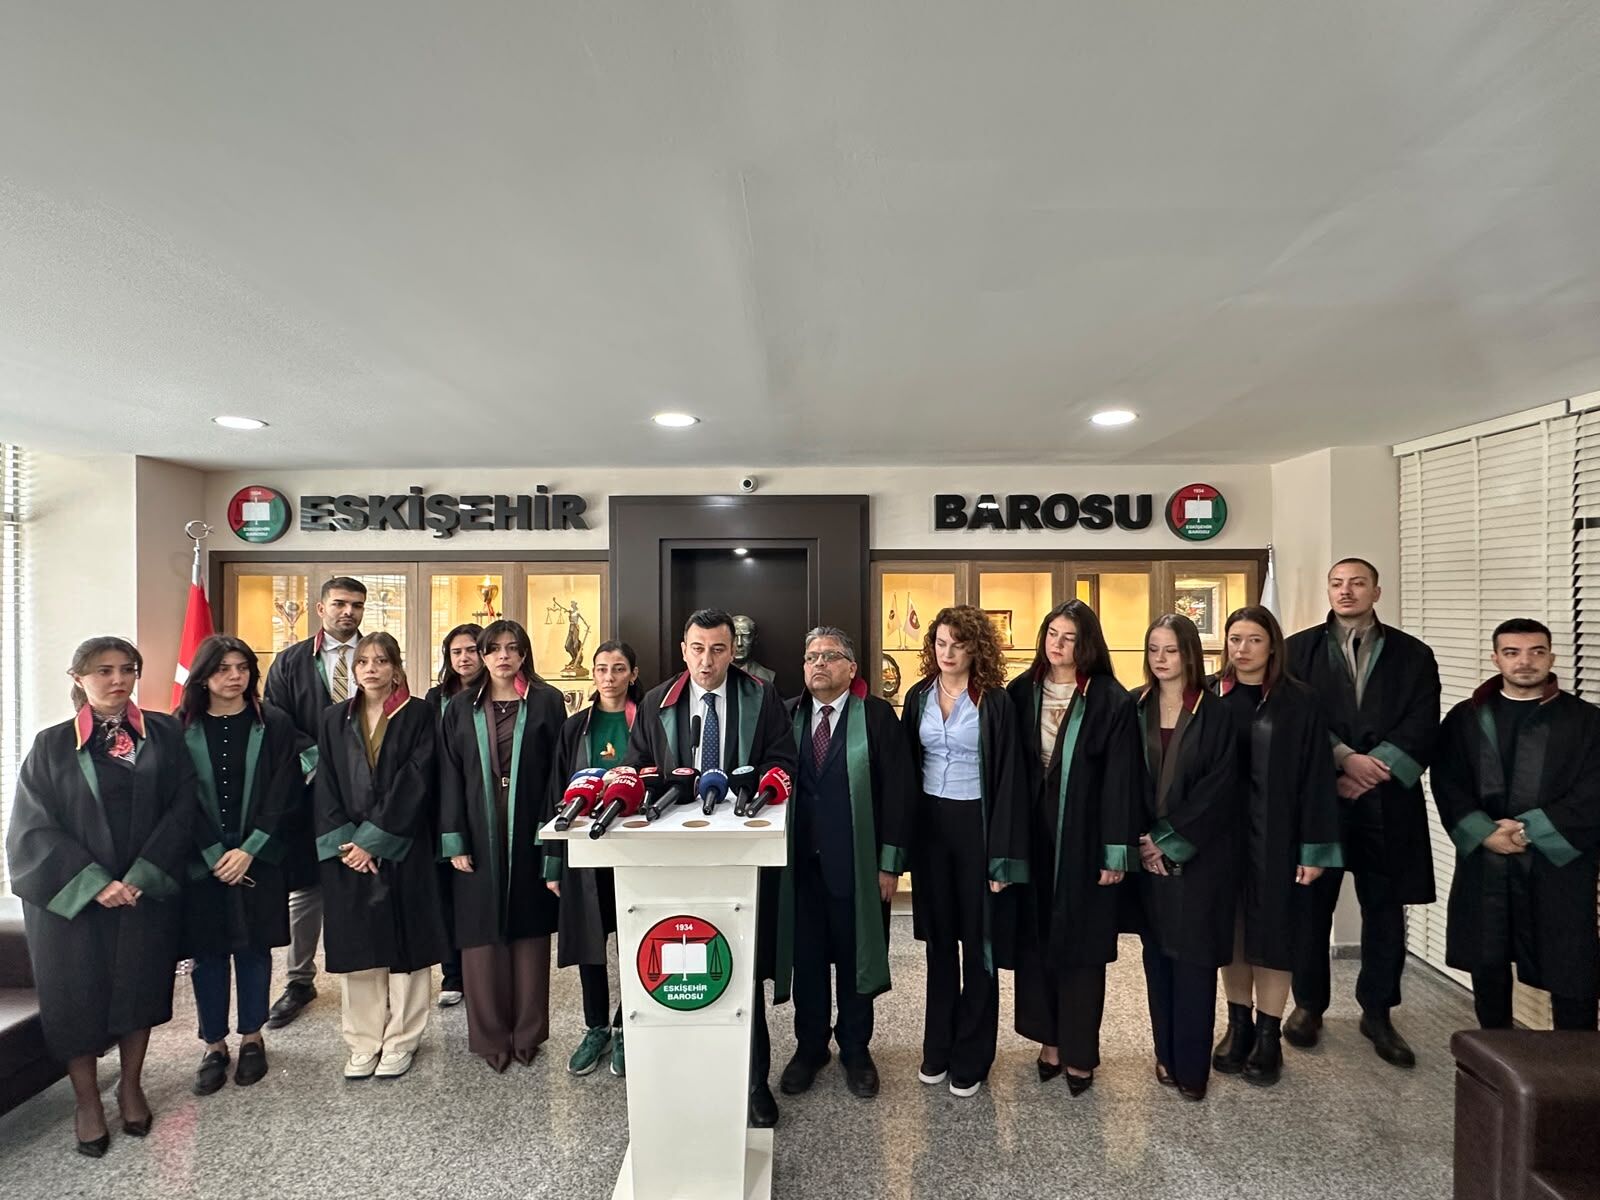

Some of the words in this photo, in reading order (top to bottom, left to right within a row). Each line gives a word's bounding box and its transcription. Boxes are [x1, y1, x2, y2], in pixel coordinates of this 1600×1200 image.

[299, 483, 590, 539] ESKİŞEHİR
[933, 492, 1153, 531] BAROSU
[674, 923, 694, 931] 1934
[663, 983, 708, 993] ESKİŞEHİR
[666, 992, 704, 1000] BAROSU
